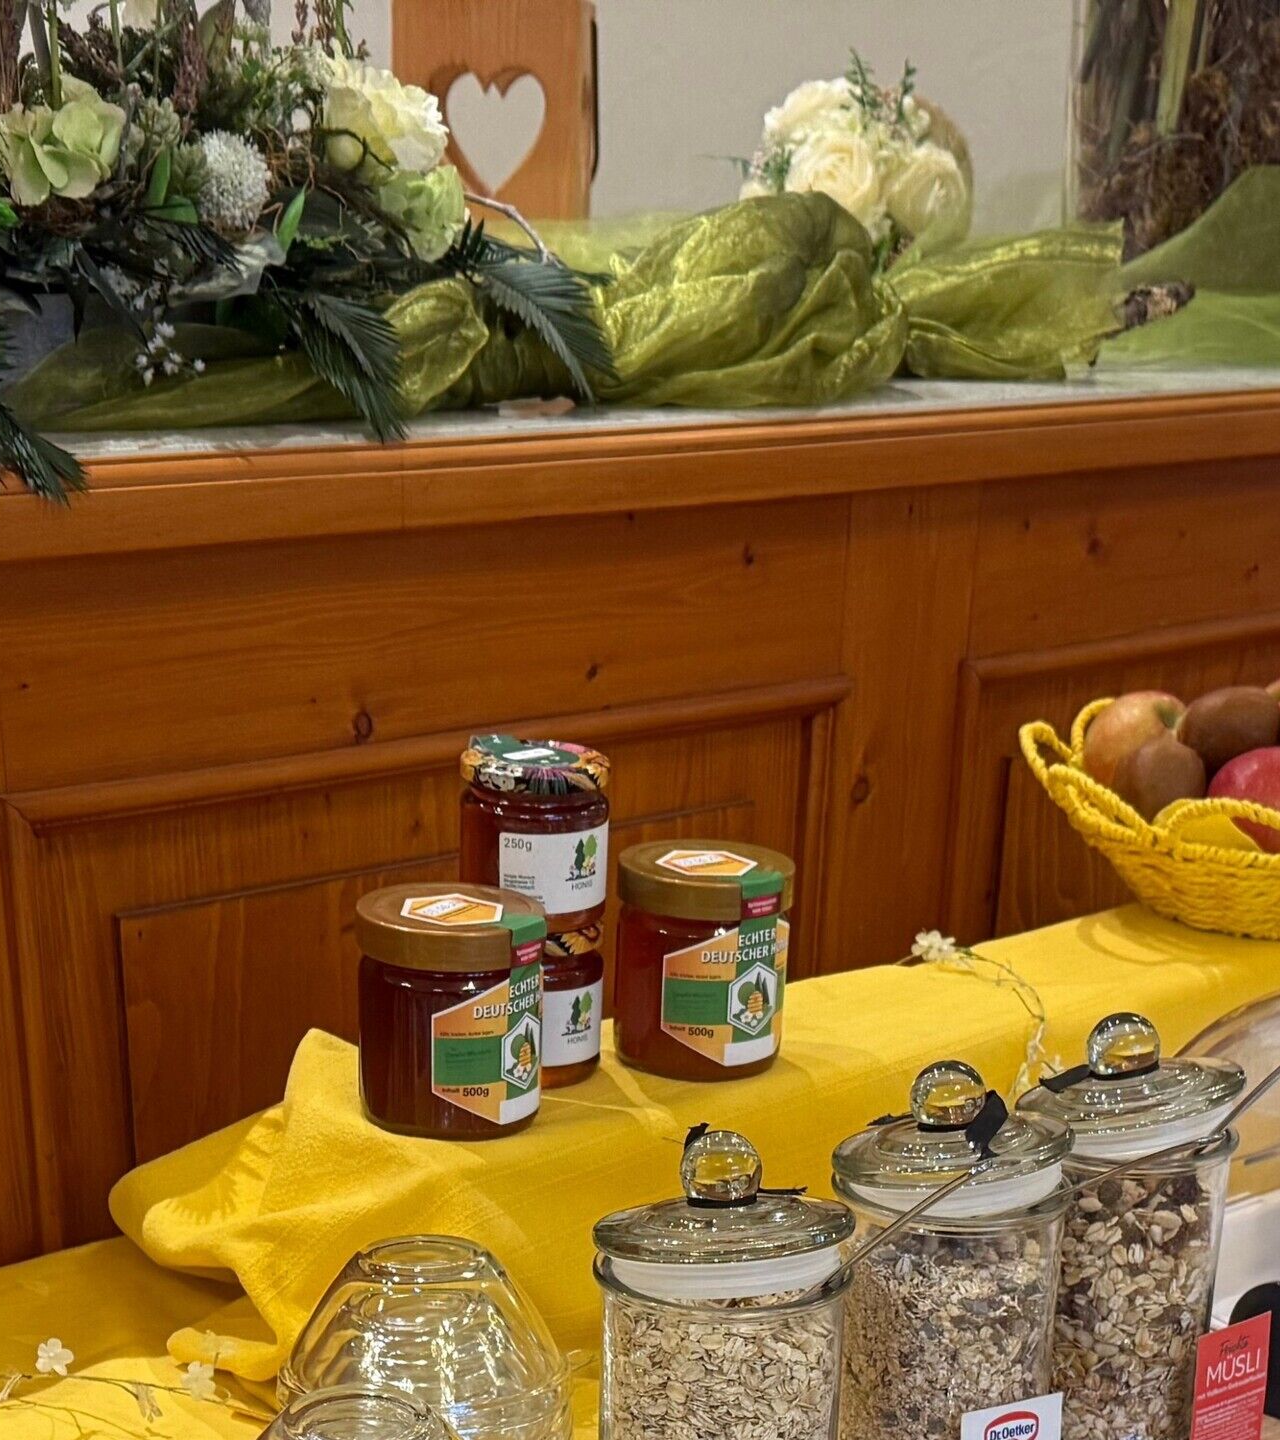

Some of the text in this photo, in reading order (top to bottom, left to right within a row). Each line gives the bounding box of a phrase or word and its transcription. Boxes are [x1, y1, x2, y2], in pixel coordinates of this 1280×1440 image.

[503, 837, 532, 852] 250g
[738, 927, 776, 947] ECHTER
[701, 945, 770, 964] DEUTSCHER
[509, 974, 540, 999] ECHTER
[473, 993, 535, 1020] DEUTSCHER
[688, 1026, 714, 1038] 500g
[462, 1086, 489, 1098] 500g
[1206, 1348, 1261, 1388] MÜSLI
